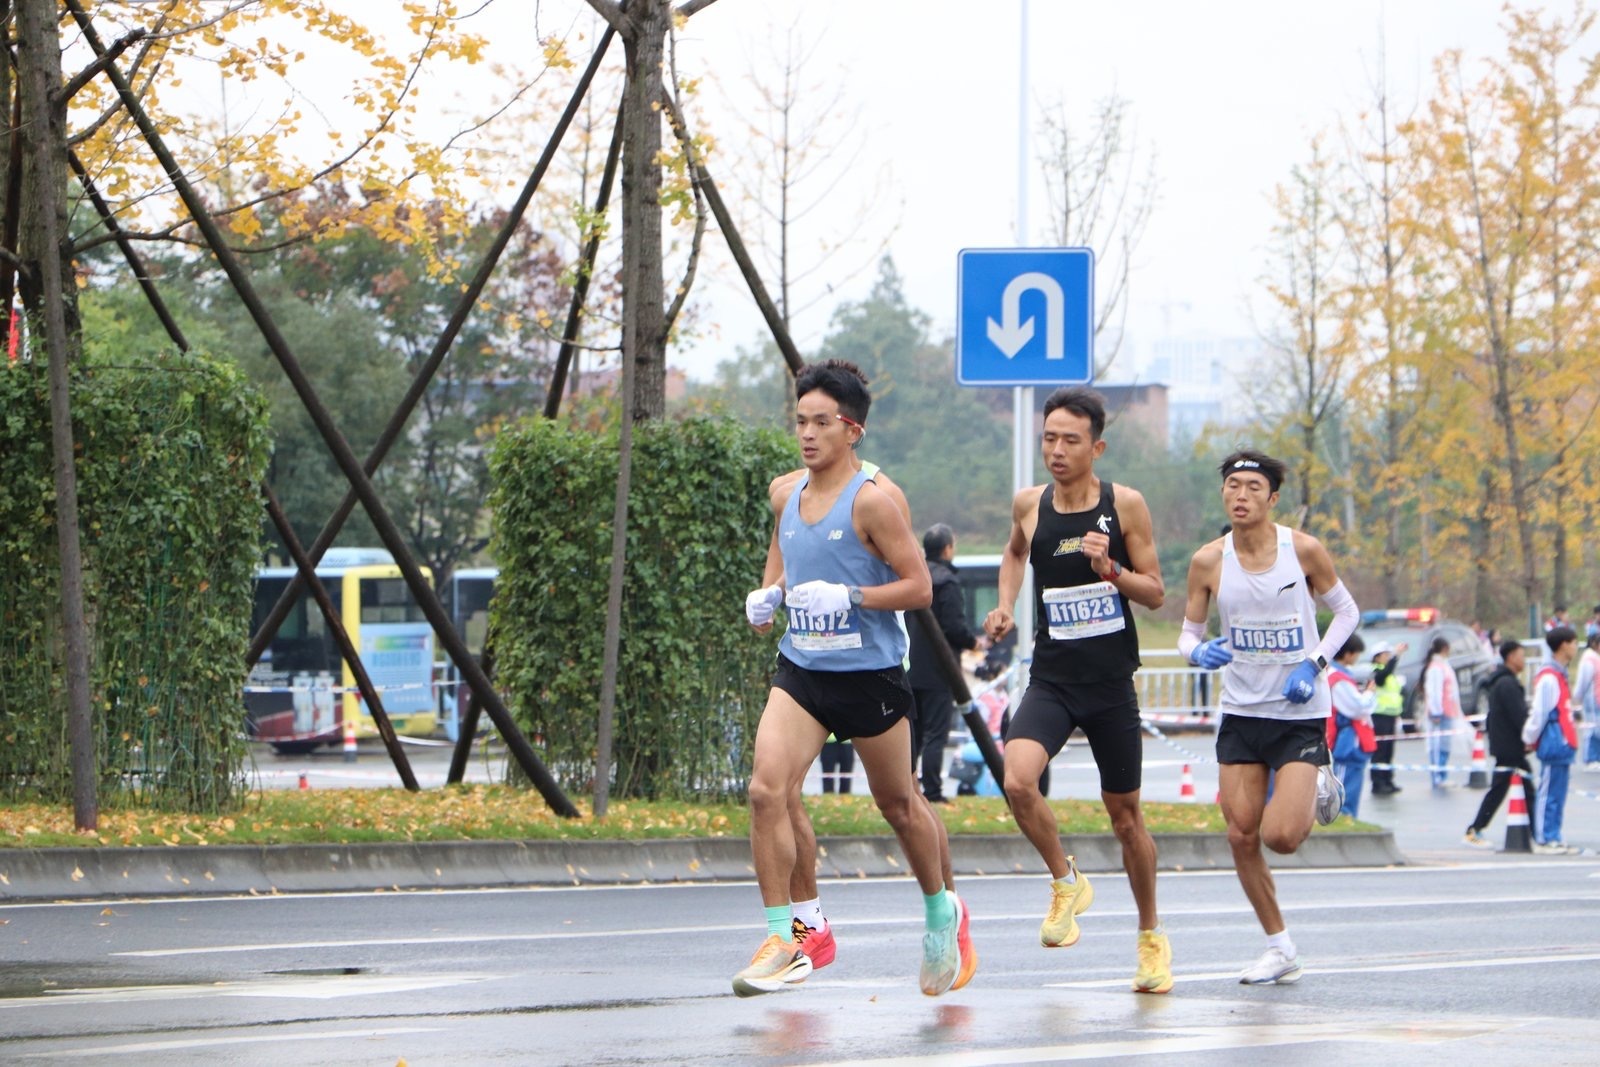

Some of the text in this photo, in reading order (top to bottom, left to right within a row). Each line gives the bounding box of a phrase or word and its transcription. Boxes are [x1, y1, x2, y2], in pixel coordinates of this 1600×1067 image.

[828, 530, 843, 540] NB
[1049, 596, 1116, 623] A11623
[1235, 628, 1299, 648] A10561
